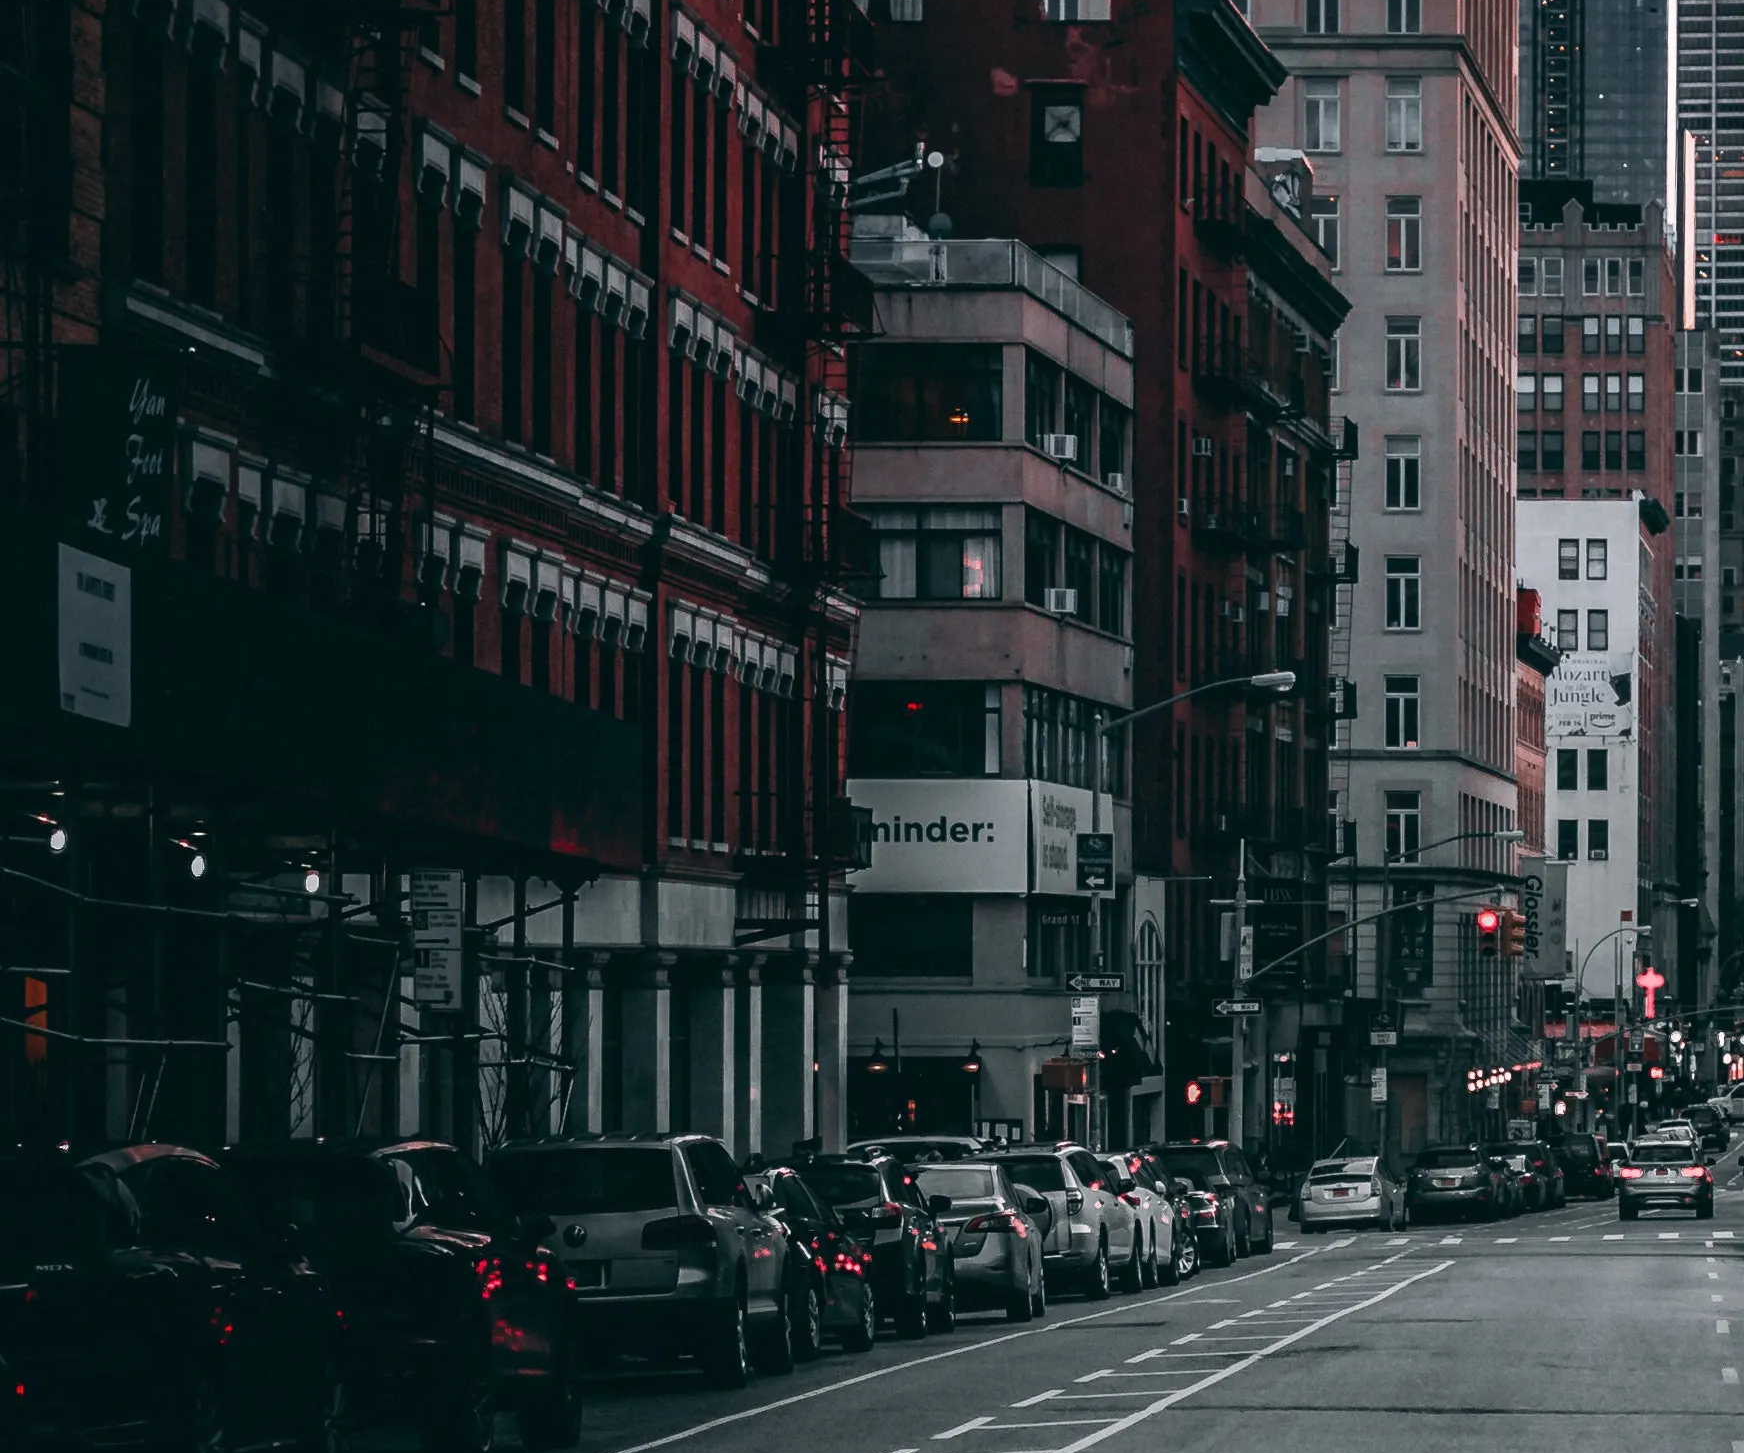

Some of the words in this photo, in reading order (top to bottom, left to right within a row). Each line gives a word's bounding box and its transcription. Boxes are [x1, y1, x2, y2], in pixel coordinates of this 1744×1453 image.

[129, 376, 165, 425] Yan
[121, 495, 161, 546] Spa
[1550, 688, 1605, 706] Jungle
[1590, 713, 1616, 721] prime
[1041, 913, 1069, 925] Grand
[1071, 913, 1081, 925] St
[1075, 979, 1091, 987] ONE
[1099, 978, 1117, 987] WAY
